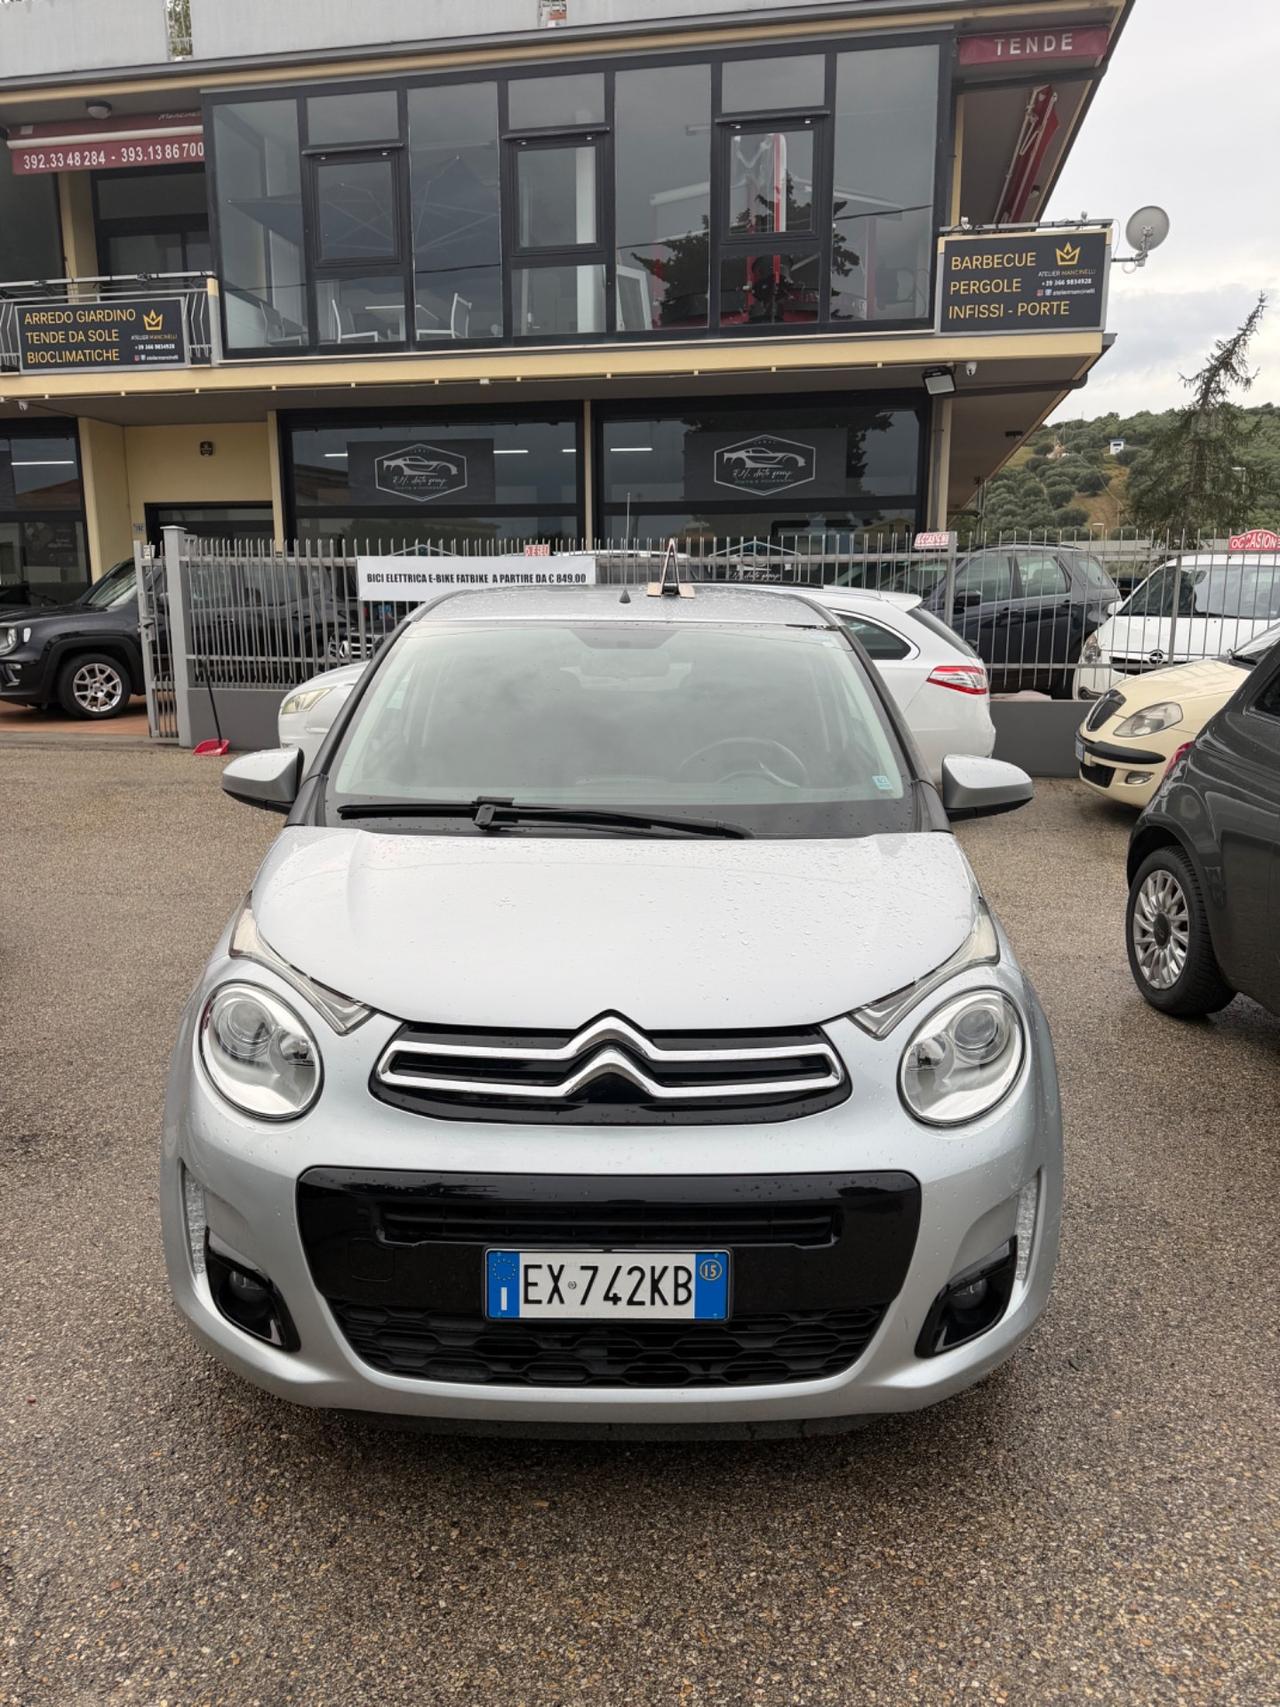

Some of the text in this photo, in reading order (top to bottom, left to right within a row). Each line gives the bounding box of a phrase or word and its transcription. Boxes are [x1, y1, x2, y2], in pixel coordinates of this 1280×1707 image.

[995, 33, 1072, 56] TENDE
[951, 252, 1037, 270] BARBECUE
[950, 278, 1022, 295] PERGOLE
[24, 308, 136, 325] ARREDO GIARDINO
[949, 304, 1004, 319] INFISSI
[1017, 301, 1070, 316] PORTE
[25, 329, 119, 344] TENDE DA SOLE
[27, 348, 120, 364] BIOCLIMATICHE
[1231, 532, 1277, 549] OCCASION
[367, 573, 384, 583] BICI
[386, 573, 427, 583] ELETTRICA
[428, 573, 455, 583] E-BIKE
[456, 573, 489, 583] FATBIKE
[492, 573, 498, 583] A
[499, 573, 534, 583] PARTIRE
[535, 573, 548, 583] DA
[556, 573, 587, 583] 849.00
[703, 1264, 717, 1278] 15
